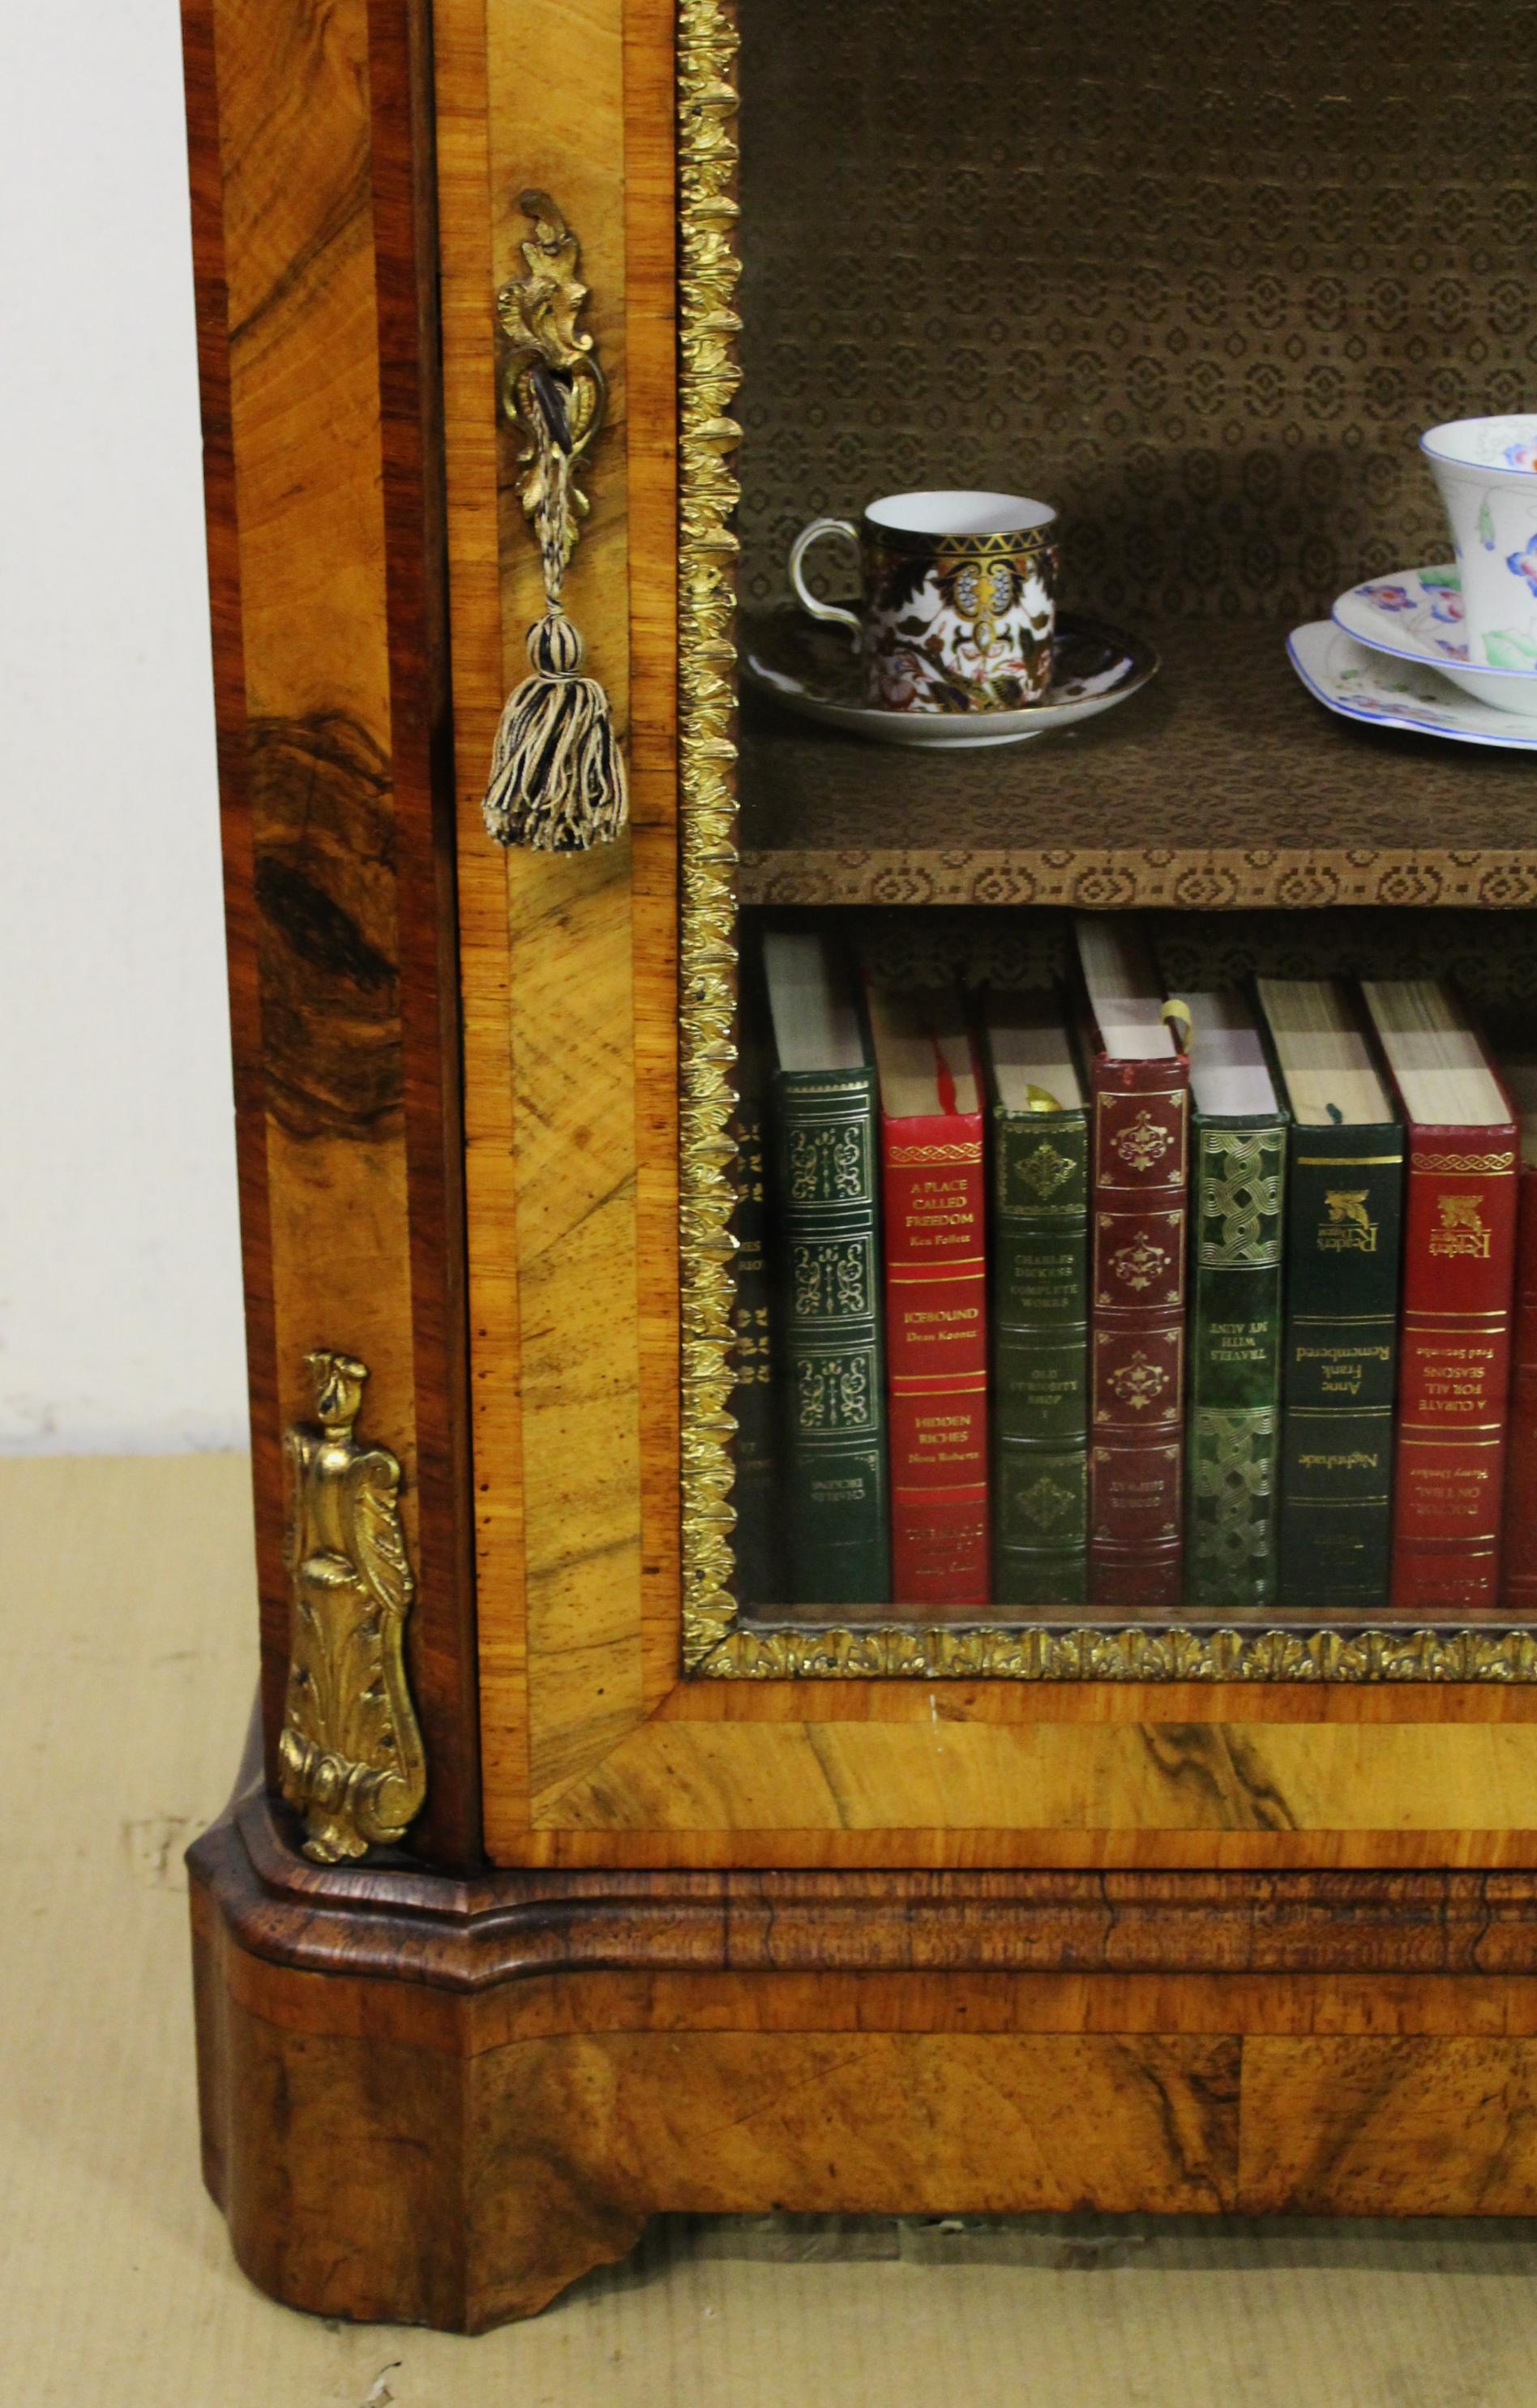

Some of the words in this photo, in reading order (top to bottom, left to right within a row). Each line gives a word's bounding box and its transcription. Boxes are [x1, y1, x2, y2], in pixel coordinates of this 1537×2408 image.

[910, 1183, 920, 1193] A
[924, 1179, 968, 1193] PLACE
[912, 1196, 968, 1210] CALLED
[906, 1214, 974, 1227] FREEDOM
[910, 1236, 931, 1246] Ken
[1317, 1228, 1378, 1252] Reader's
[1428, 1234, 1491, 1258] Reader's
[1014, 1254, 1074, 1265] CHARLES
[1014, 1267, 1072, 1278] DICKENS
[1010, 1284, 1078, 1296] COMPLETE
[1021, 1298, 1069, 1308] WORKS
[903, 1308, 979, 1323] ICEBOUND
[1209, 1323, 1246, 1334] AUNT
[1248, 1322, 1268, 1334] MY
[906, 1332, 935, 1342] Dean
[1222, 1337, 1256, 1348] WITH
[1210, 1348, 1267, 1361] TRAVELS
[1296, 1347, 1390, 1362] Remembered
[1031, 1369, 1058, 1379] OLD
[1321, 1365, 1362, 1379] Frank
[1424, 1367, 1486, 1379] SEASONS
[1321, 1381, 1362, 1395] Anne
[1424, 1383, 1450, 1395] ALL
[1454, 1383, 1483, 1395] FOR
[1419, 1399, 1475, 1412] CURATE
[1476, 1399, 1487, 1411] A
[914, 1415, 972, 1429] HIDDEN
[918, 1431, 970, 1444] RICHES
[1298, 1452, 1378, 1469] Nightshade
